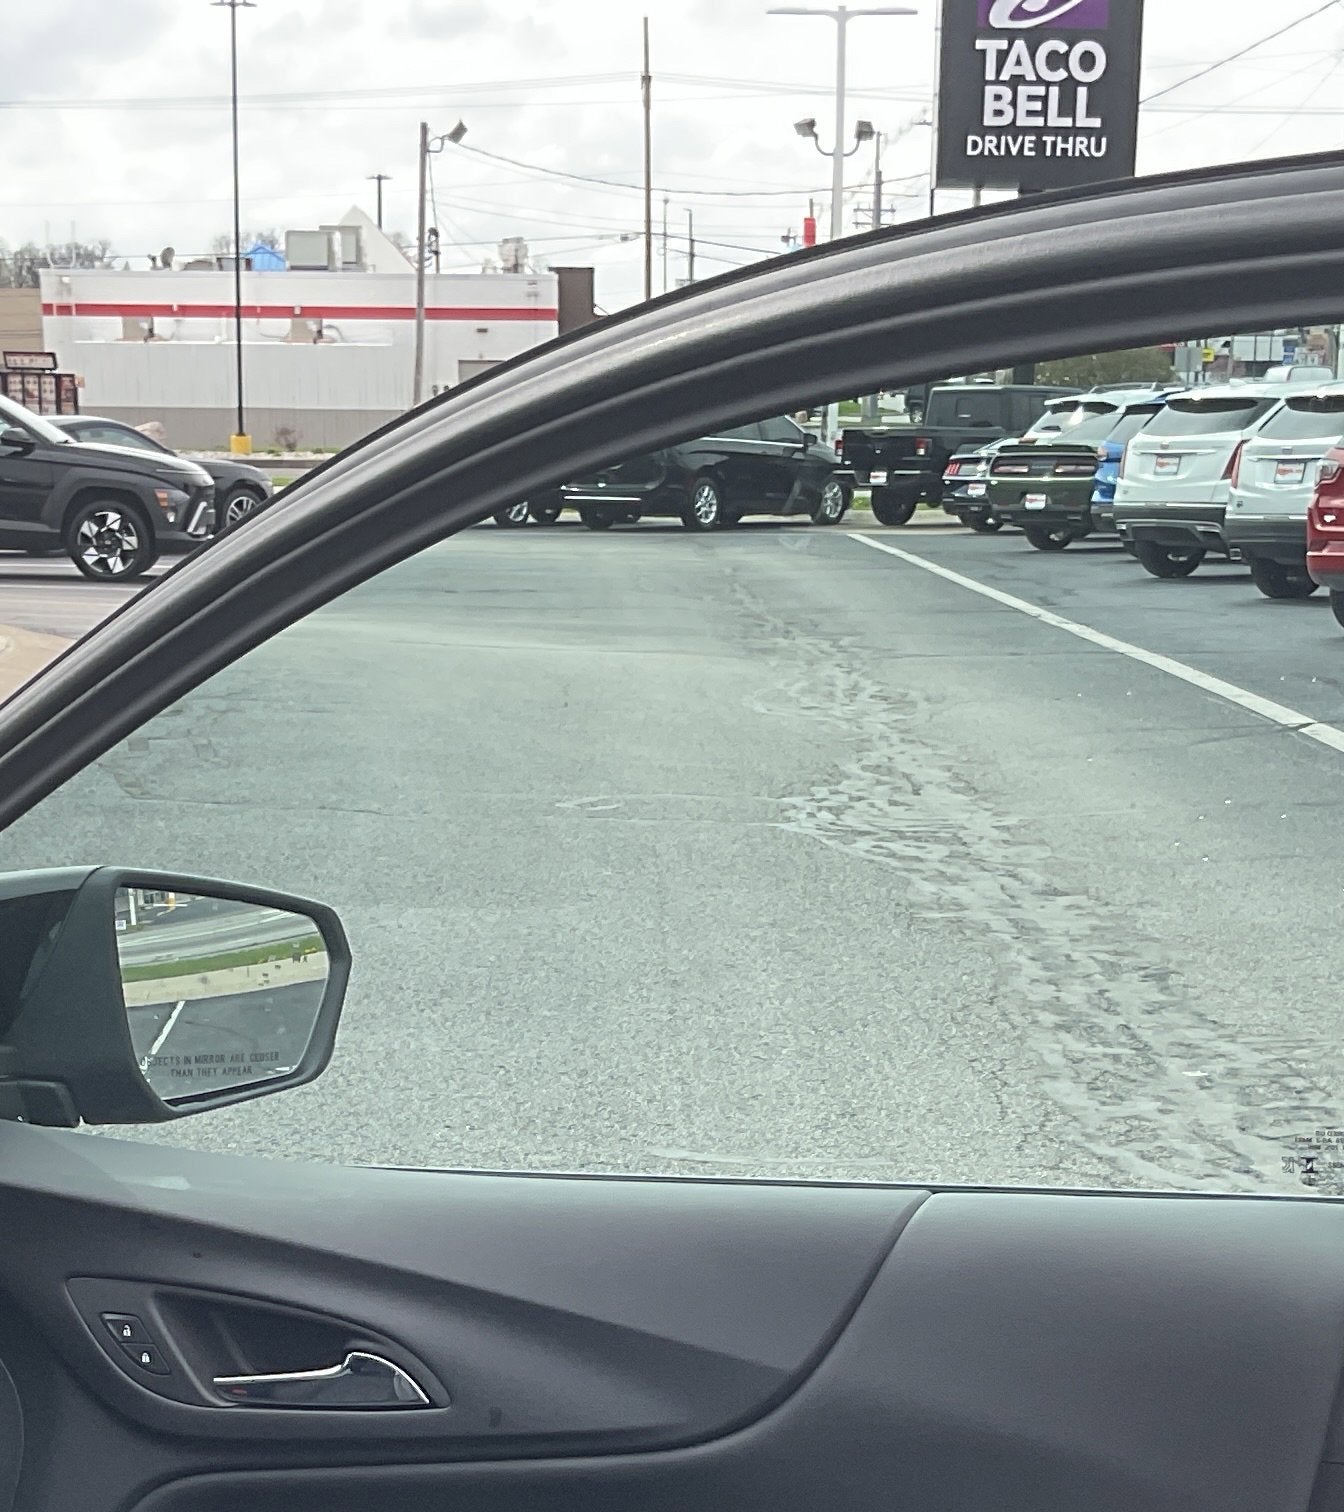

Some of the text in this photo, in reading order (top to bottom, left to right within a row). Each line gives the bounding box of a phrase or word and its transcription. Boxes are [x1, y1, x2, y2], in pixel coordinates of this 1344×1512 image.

[975, 39, 1107, 83] TACO
[983, 85, 1102, 128] BELL
[966, 135, 1107, 158] DRIVE THRU
[183, 1054, 192, 1065] IN
[194, 1053, 227, 1064] MIRROR
[230, 1053, 245, 1063] ARE
[249, 1051, 280, 1063] CLOSER
[171, 1065, 253, 1078] THAN THEY APPEAR
